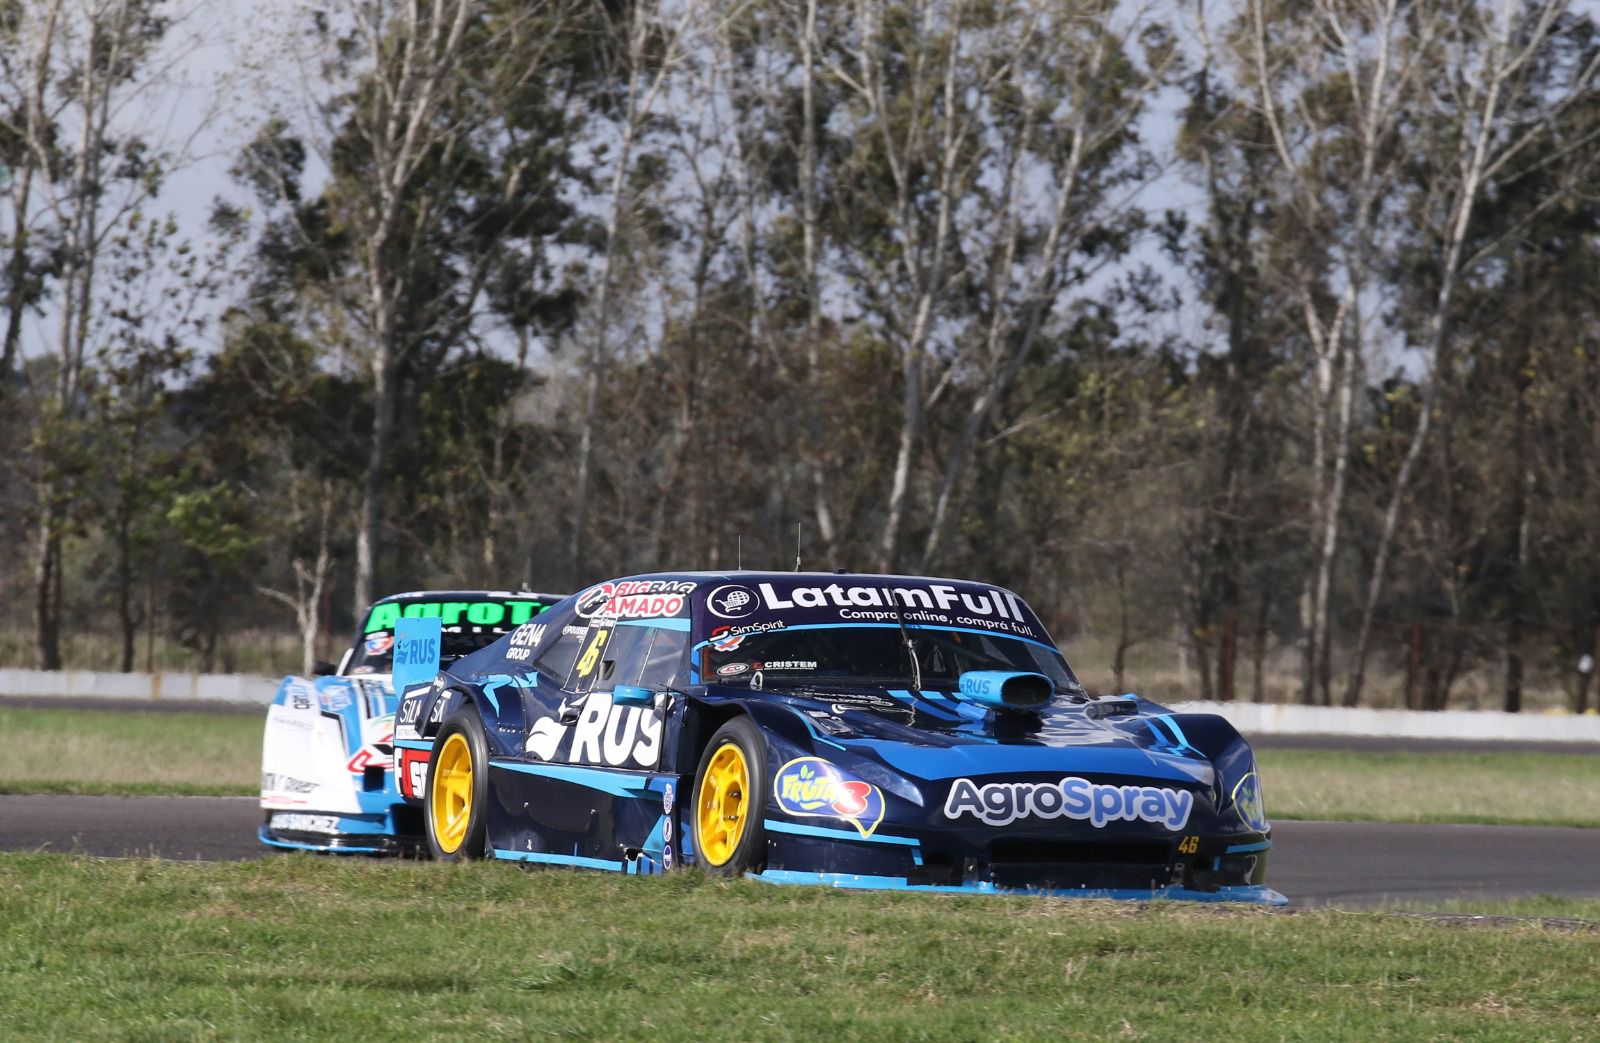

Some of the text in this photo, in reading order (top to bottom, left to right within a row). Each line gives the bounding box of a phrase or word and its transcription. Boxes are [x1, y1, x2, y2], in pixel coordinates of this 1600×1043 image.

[614, 581, 697, 597] BIGBAG
[603, 597, 683, 616] AMADO
[759, 583, 1025, 622] LatamFull
[509, 623, 548, 648] GEN4
[730, 619, 786, 636] SimSpirit
[956, 616, 1009, 630] comprá
[1010, 622, 1038, 639] full.
[410, 637, 437, 666] RUS
[505, 647, 532, 661] GROUP
[764, 660, 818, 669] CRISTEM
[966, 678, 991, 695] RUS
[568, 692, 676, 767] RUS
[944, 776, 1194, 832] AgroSpray
[1177, 835, 1200, 854] 46
